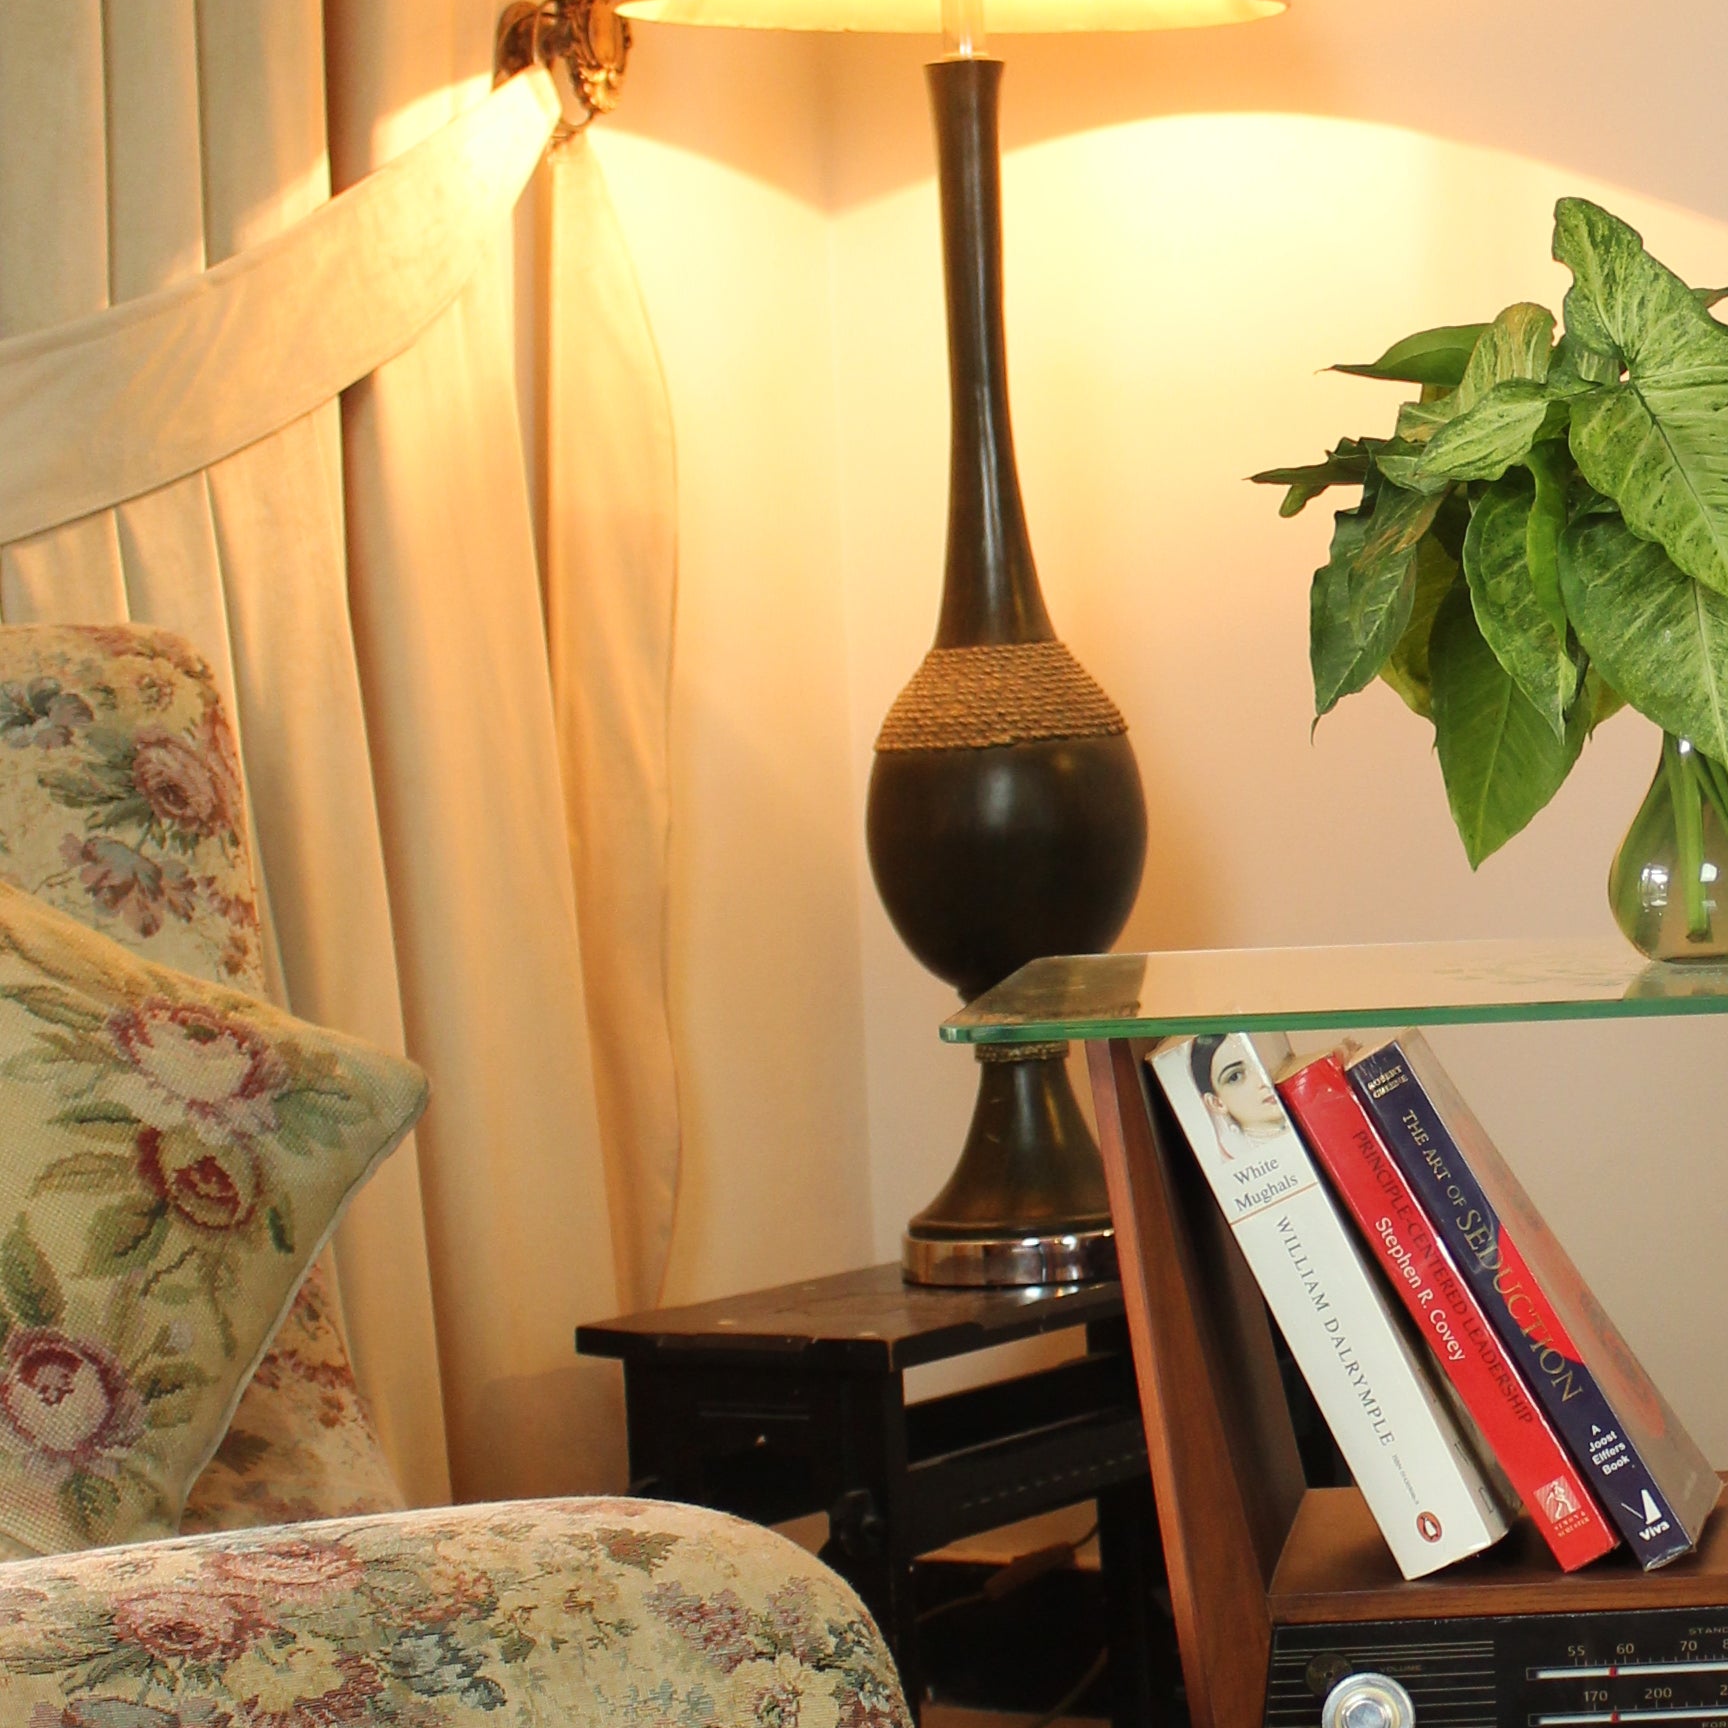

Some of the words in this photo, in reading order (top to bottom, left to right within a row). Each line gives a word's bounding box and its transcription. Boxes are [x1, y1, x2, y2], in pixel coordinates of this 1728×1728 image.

[1402, 1109, 1430, 1146] THE
[1233, 1159, 1279, 1184] White
[1423, 1148, 1451, 1182] ART
[1234, 1175, 1298, 1211] Mughals
[1447, 1184, 1467, 1208] OF
[1352, 1130, 1470, 1316] PRINCIPLE-CENTERED
[1462, 1314, 1534, 1423] LEADERSHIP
[1375, 1217, 1422, 1290] Stephen
[1417, 1288, 1434, 1309] R.
[1429, 1308, 1466, 1363] Covey
[1456, 1209, 1584, 1403] SEDUCTION
[1276, 1216, 1330, 1312] WILLIAM
[1324, 1317, 1395, 1446] DALRYMPLE
[1589, 1430, 1618, 1452] Joost
[1591, 1424, 1601, 1436] A
[1602, 1455, 1630, 1476] Book
[1639, 1521, 1670, 1541] Viva
[1568, 1645, 1585, 1656] 55
[1616, 1643, 1635, 1654] 60
[1680, 1640, 1698, 1651] 70
[1584, 1690, 1608, 1702] 170
[1644, 1687, 1672, 1699] 200
